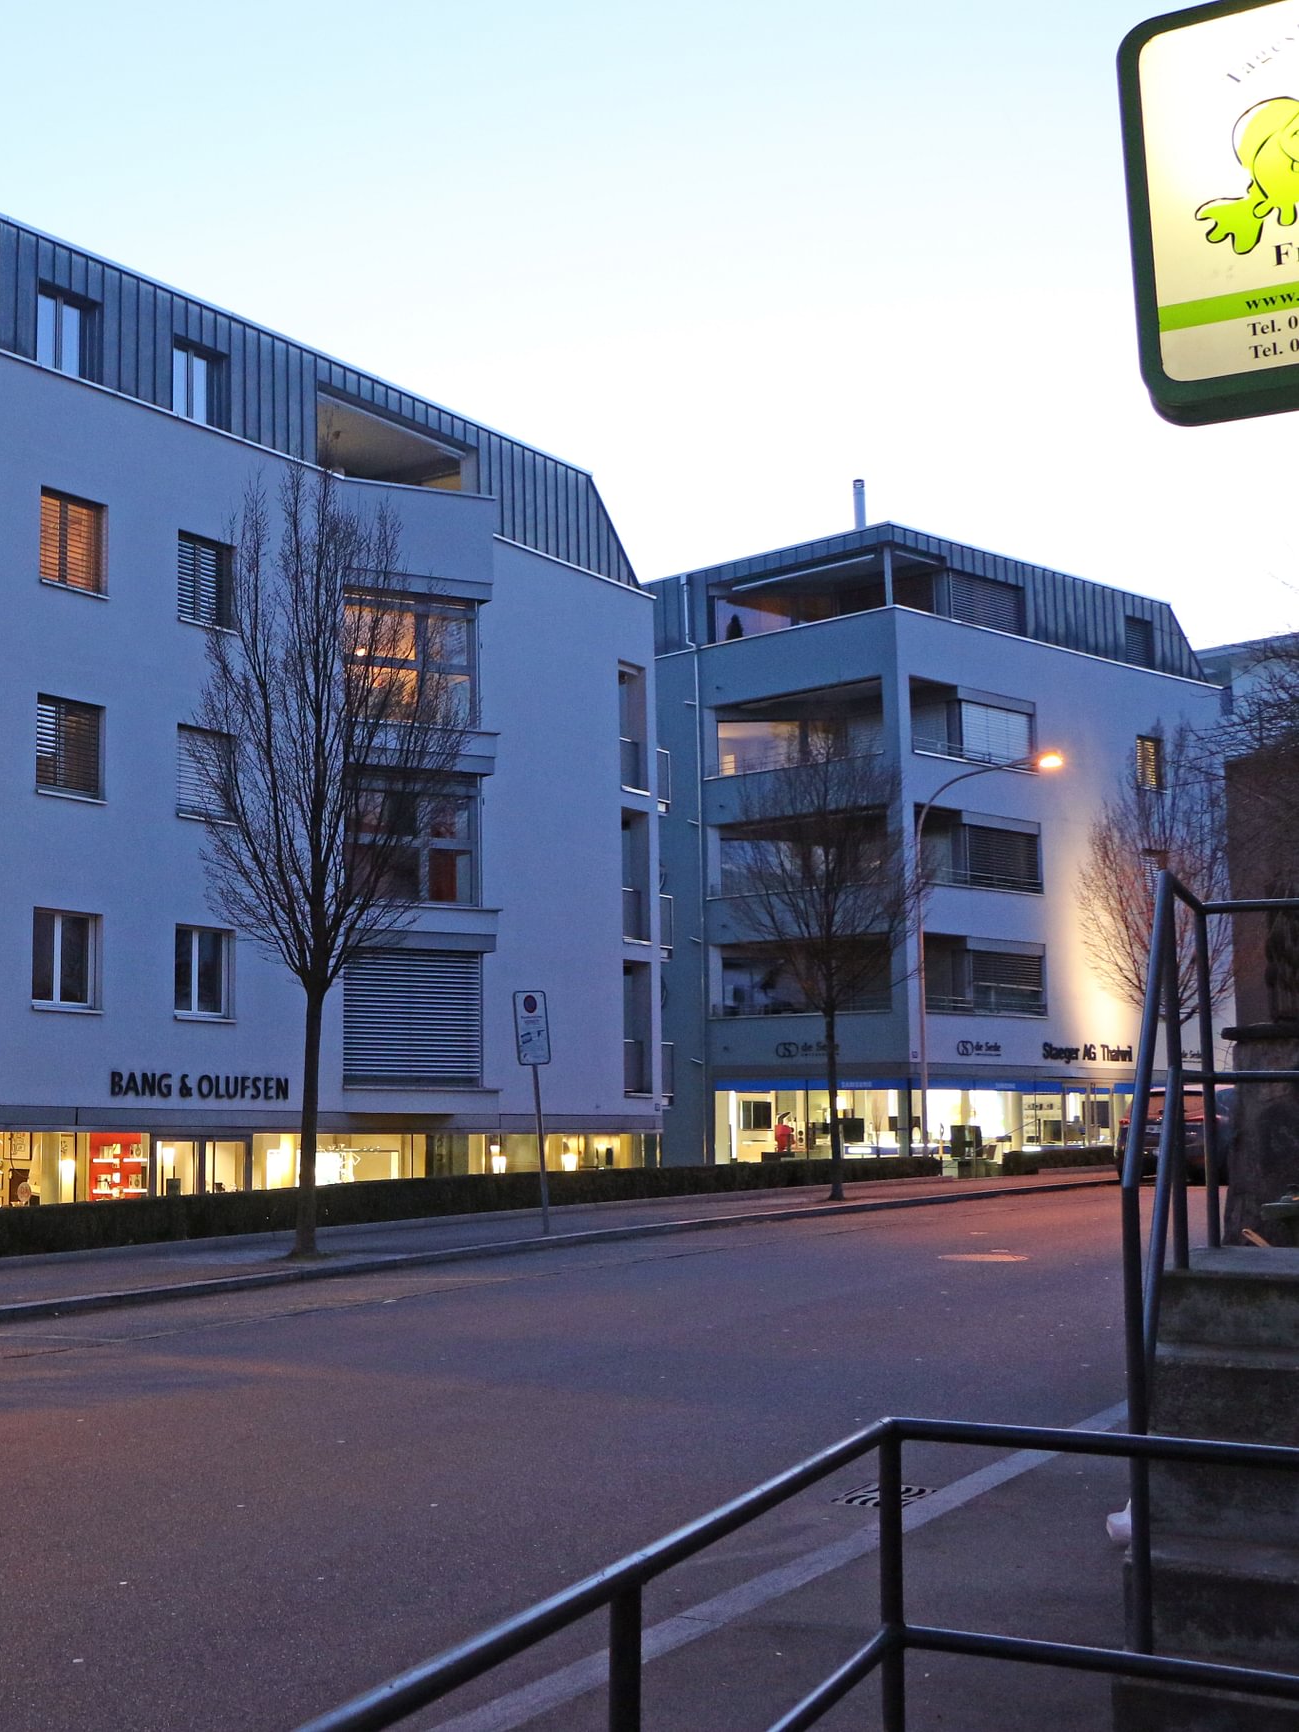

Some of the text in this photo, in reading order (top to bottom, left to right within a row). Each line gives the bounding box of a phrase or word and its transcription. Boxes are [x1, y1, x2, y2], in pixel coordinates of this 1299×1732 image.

[1247, 319, 1281, 336] Tel.
[1249, 342, 1283, 359] Tel.
[1043, 1042, 1133, 1064] Staeger AG Thalwil
[110, 1071, 289, 1100] BANG & OLUFSEN
